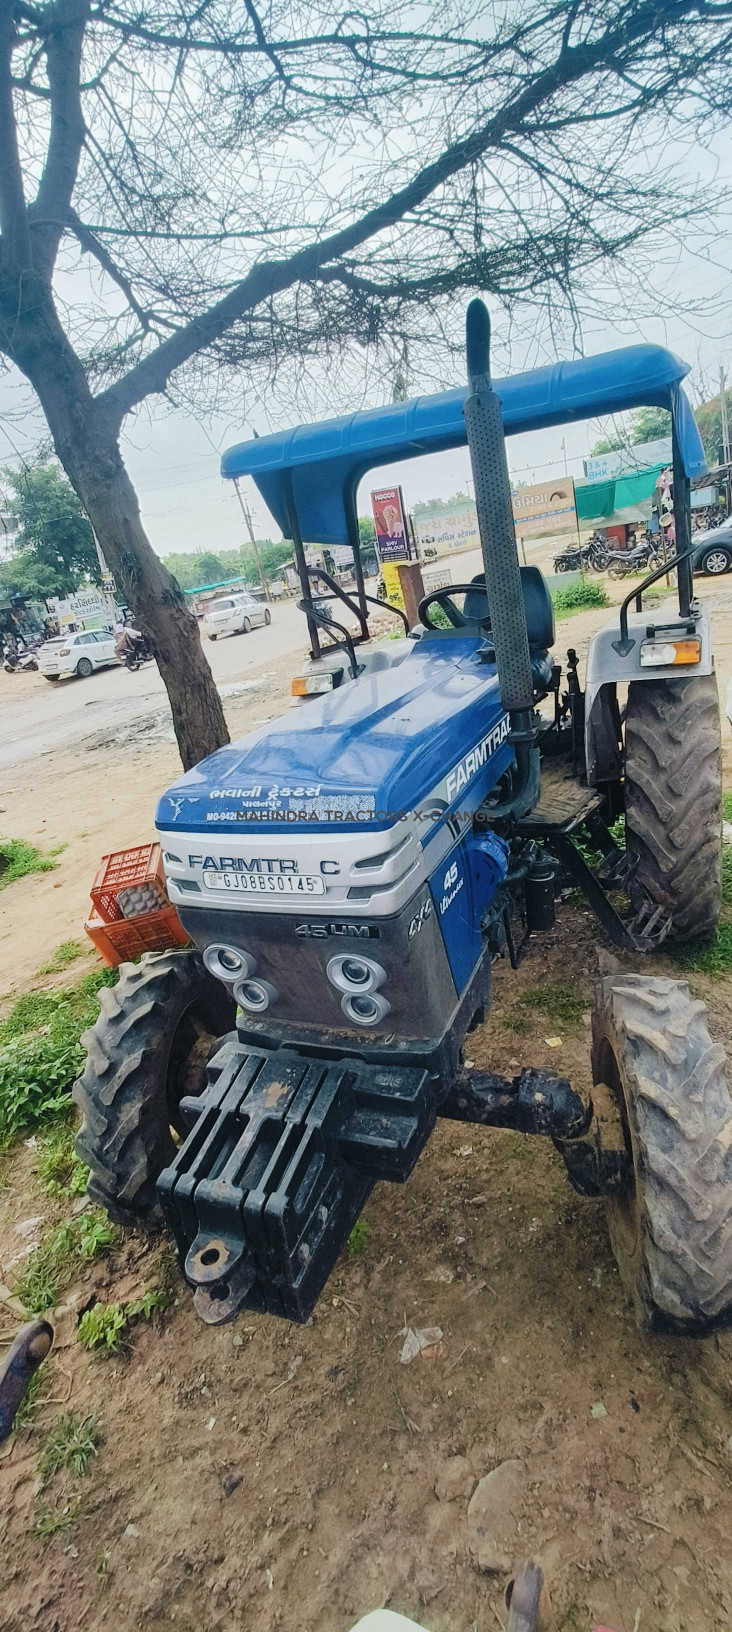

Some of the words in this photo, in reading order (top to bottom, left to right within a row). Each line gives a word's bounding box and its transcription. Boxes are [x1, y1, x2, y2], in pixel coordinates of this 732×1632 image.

[588, 466, 607, 480] BHK
[374, 491, 396, 501] HOCCO
[380, 544, 405, 553] PARLOUR
[209, 785, 262, 799] ભવાની
[242, 800, 282, 810] પાલનપુર
[223, 873, 315, 892] GJ08BS0145
[443, 861, 458, 891] 45
